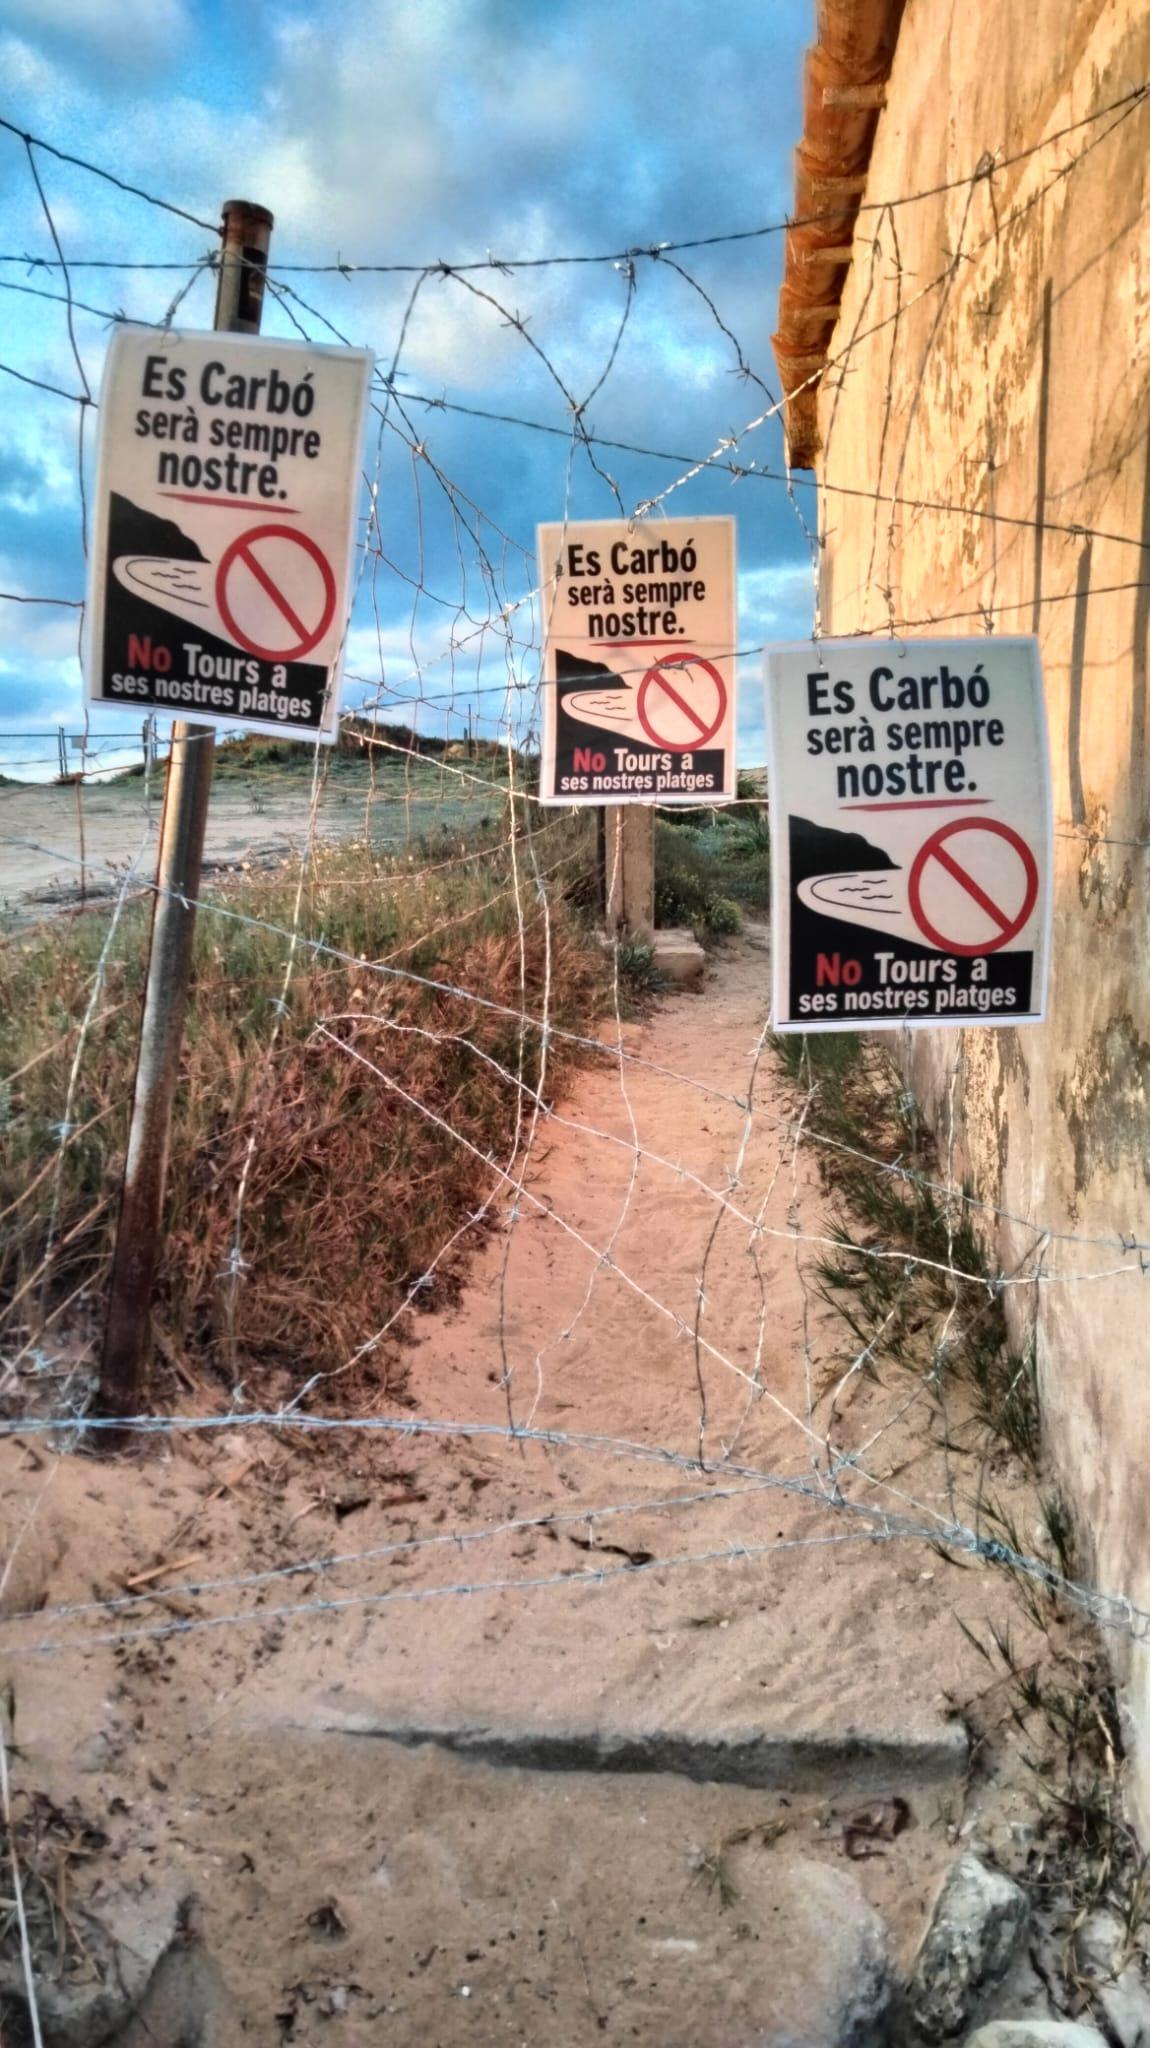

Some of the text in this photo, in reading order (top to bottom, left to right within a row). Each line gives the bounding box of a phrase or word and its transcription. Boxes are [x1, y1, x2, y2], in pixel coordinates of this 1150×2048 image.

[142, 355, 314, 418] Es Carbó
[135, 407, 320, 462] serà sempre
[157, 451, 287, 500] nostre.
[568, 538, 697, 576] Es Carbó
[568, 578, 705, 608] serà sempre
[589, 607, 685, 638] nostre.
[128, 633, 287, 688] No Tours a
[111, 672, 311, 719] ses nostres platges
[807, 665, 989, 716] Es Carbó
[807, 717, 1004, 756] serà sempre
[573, 747, 693, 773] No Tours a
[837, 754, 976, 798] nostre.
[561, 772, 714, 791] ses nostres platges
[816, 952, 988, 987] No Tours a
[799, 984, 1016, 1012] ses nostres platges
